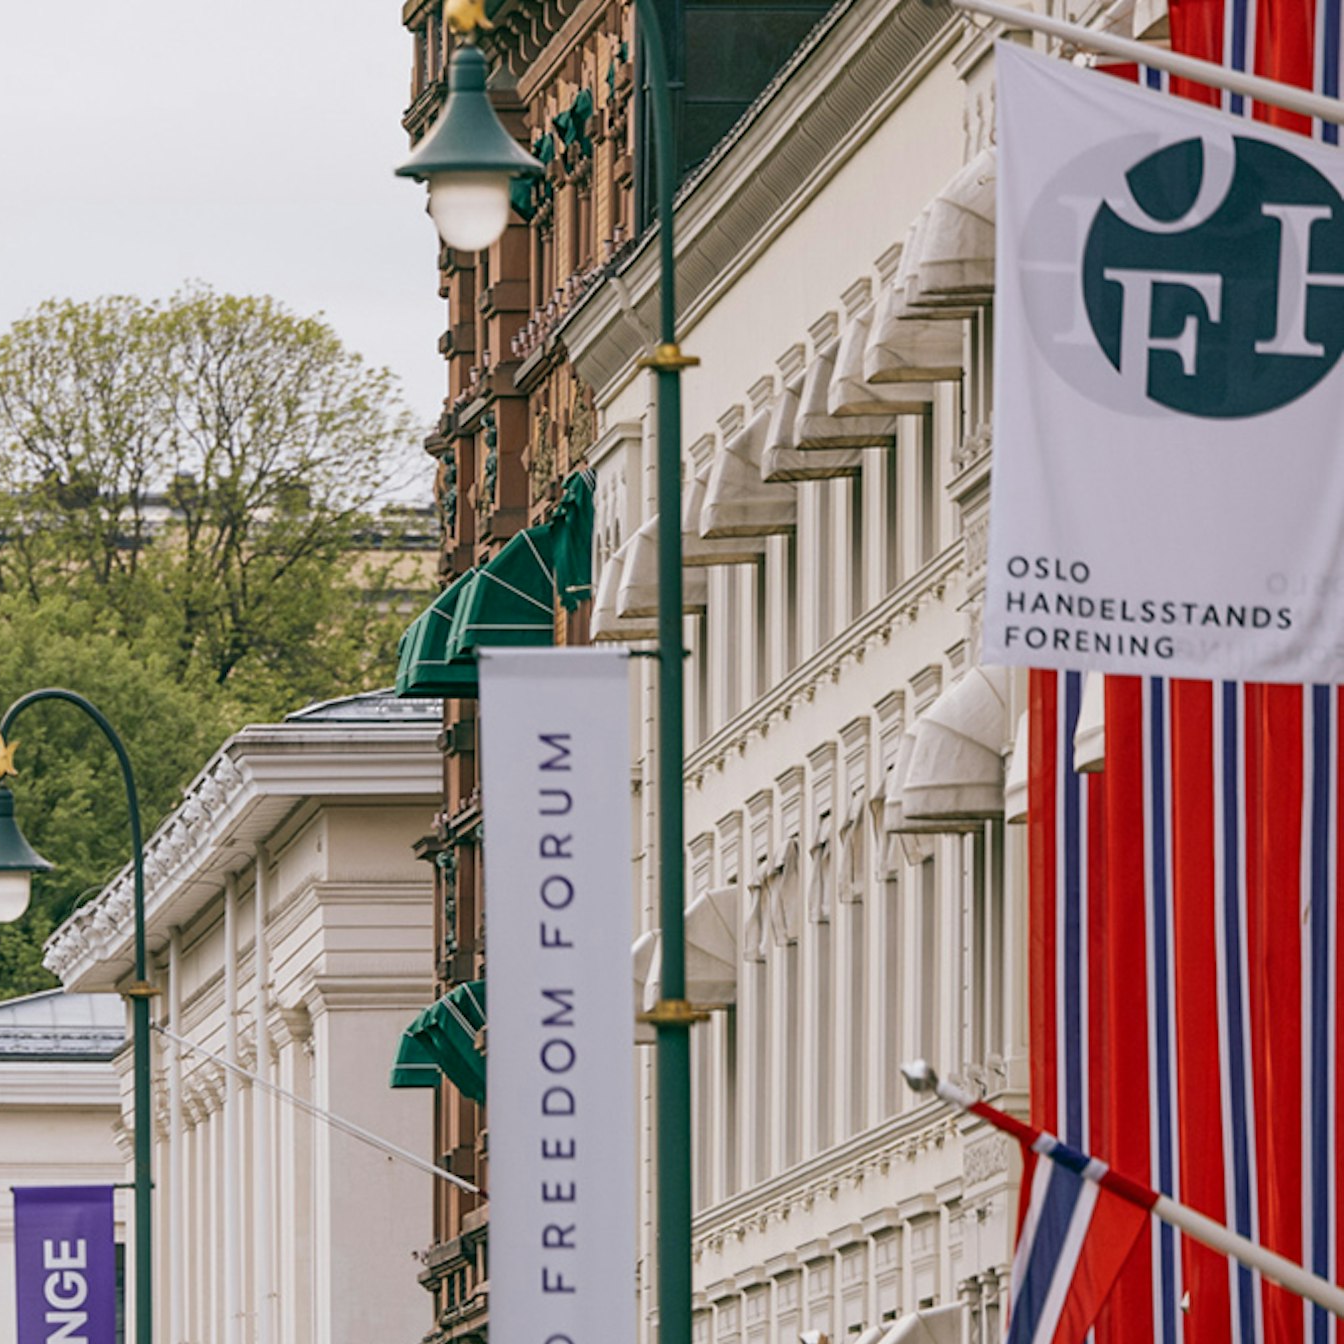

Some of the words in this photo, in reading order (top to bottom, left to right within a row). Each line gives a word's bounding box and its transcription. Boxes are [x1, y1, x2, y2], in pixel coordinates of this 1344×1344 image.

[1006, 555, 1091, 585] OSLO
[1005, 591, 1293, 631] HANDELSSTANDS
[1003, 625, 1175, 660] FORENING
[537, 733, 574, 949] FORUM
[540, 988, 576, 1294] FREEDOM
